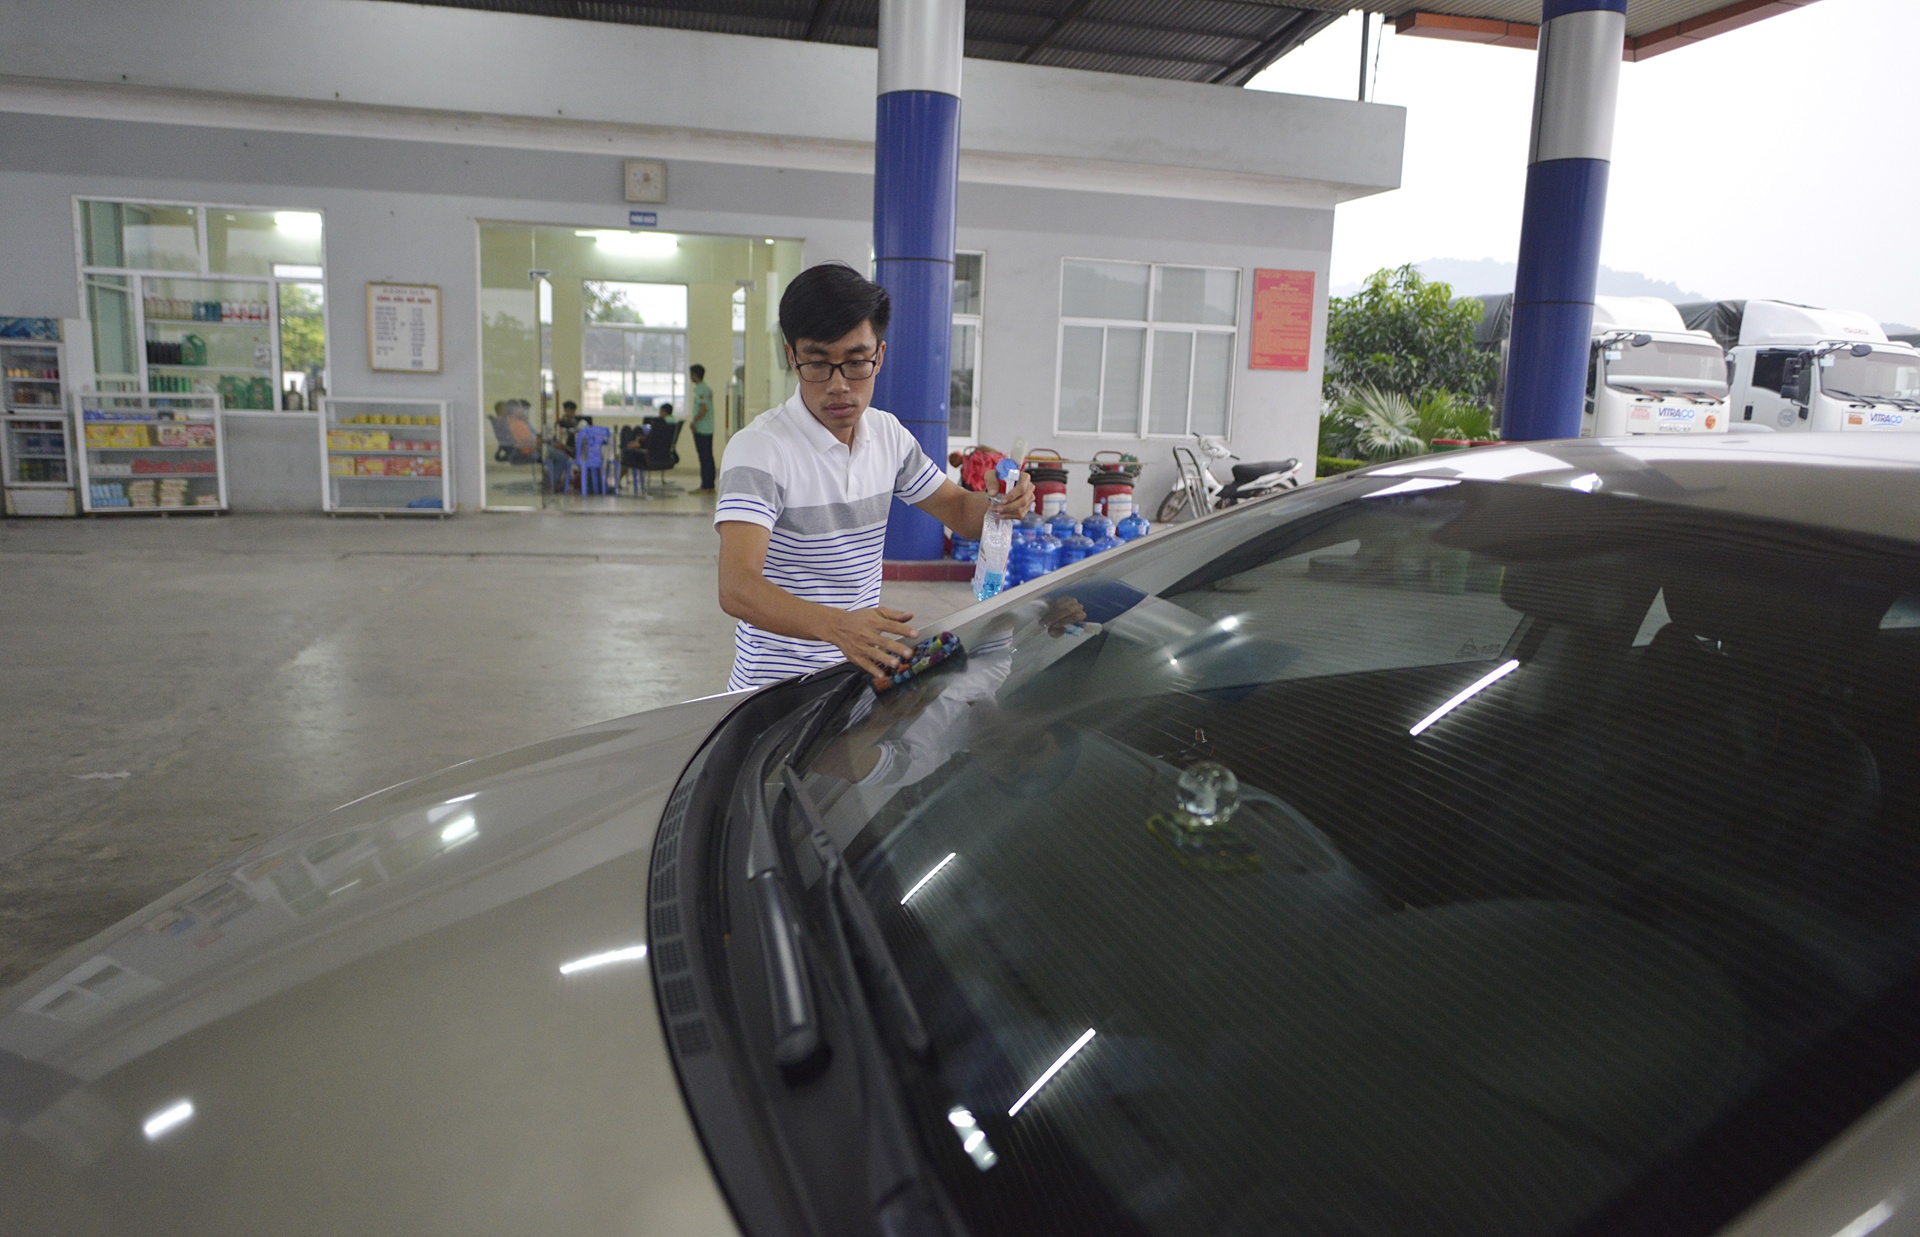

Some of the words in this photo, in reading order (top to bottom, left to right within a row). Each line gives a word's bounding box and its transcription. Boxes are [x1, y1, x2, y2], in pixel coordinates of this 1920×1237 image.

[1843, 327, 1869, 336] ISUZU
[1658, 407, 1695, 419] VITRACO
[1870, 413, 1903, 424] VITRACO
